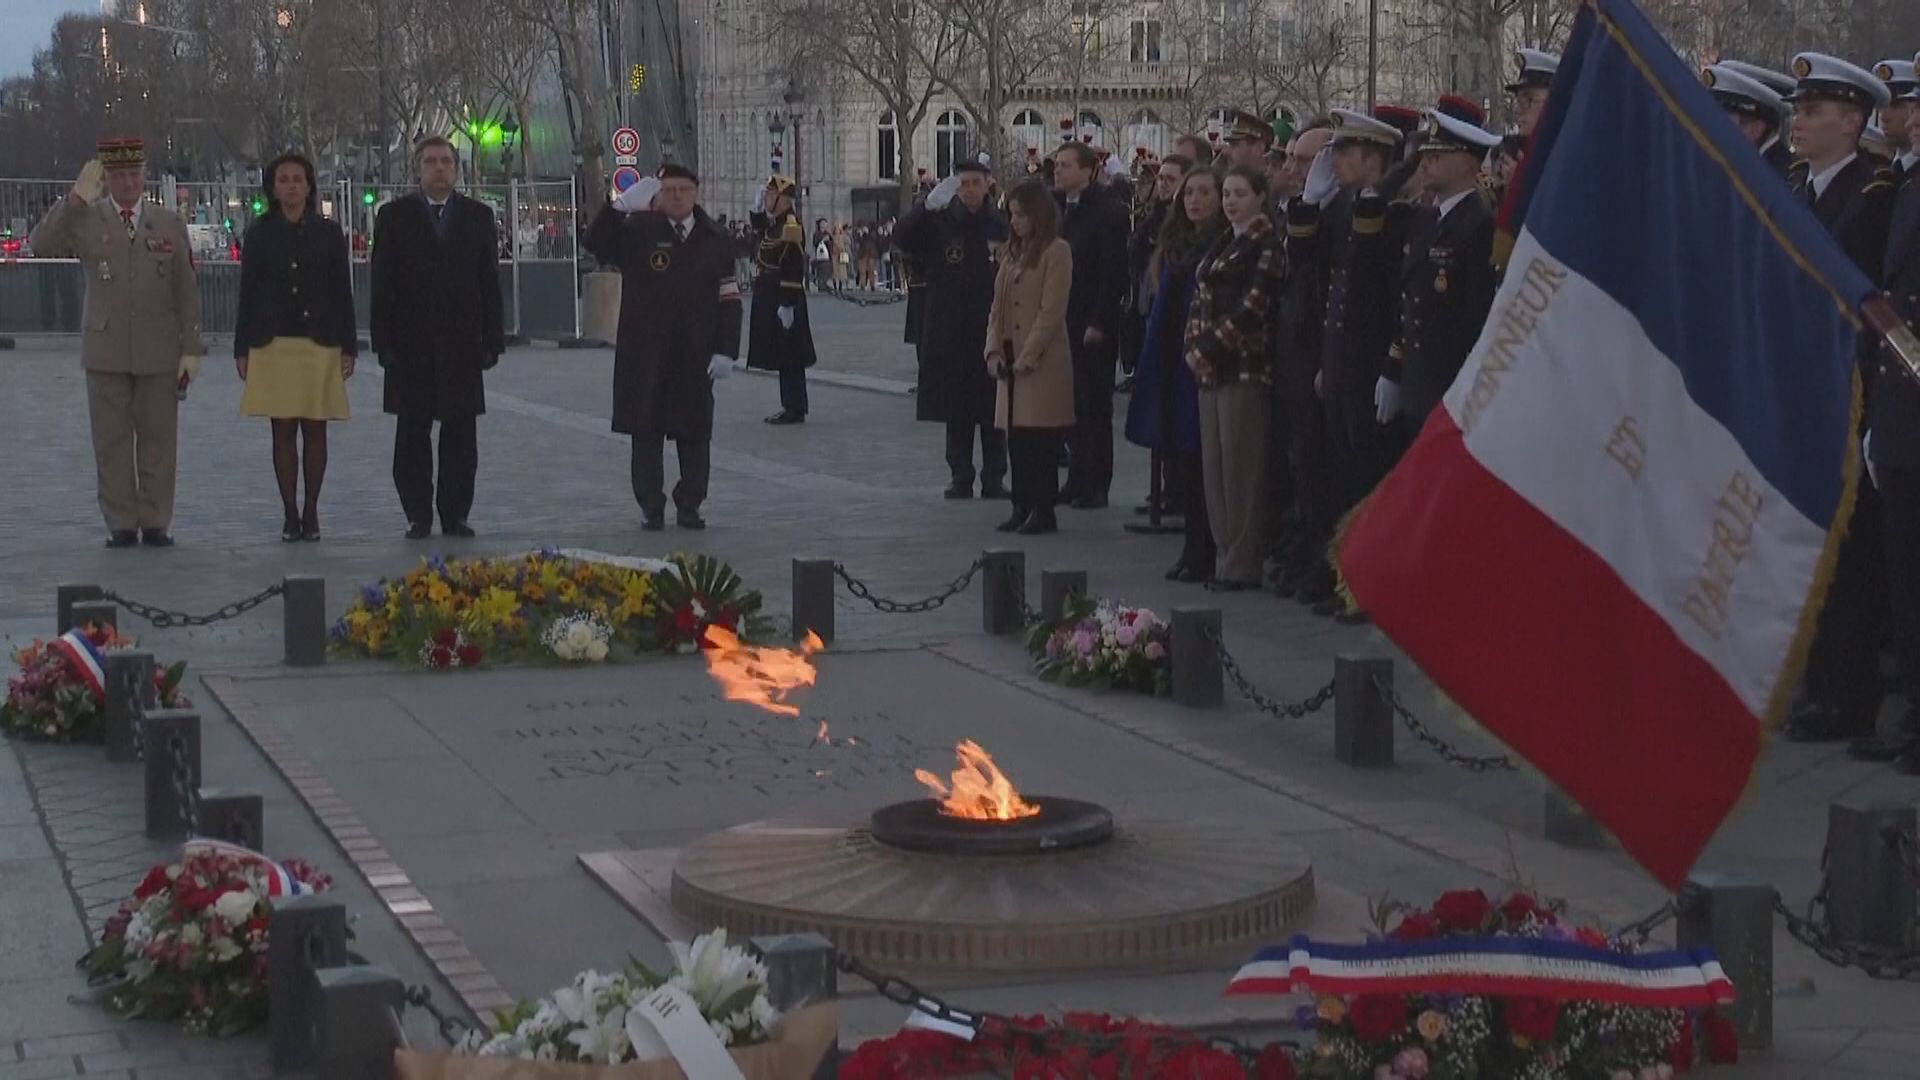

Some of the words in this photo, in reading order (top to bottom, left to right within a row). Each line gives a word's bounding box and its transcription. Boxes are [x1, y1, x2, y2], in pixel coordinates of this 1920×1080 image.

[620, 136, 634, 149] 50
[1605, 415, 1647, 481] ET
[1680, 470, 1764, 640] PATRIE
